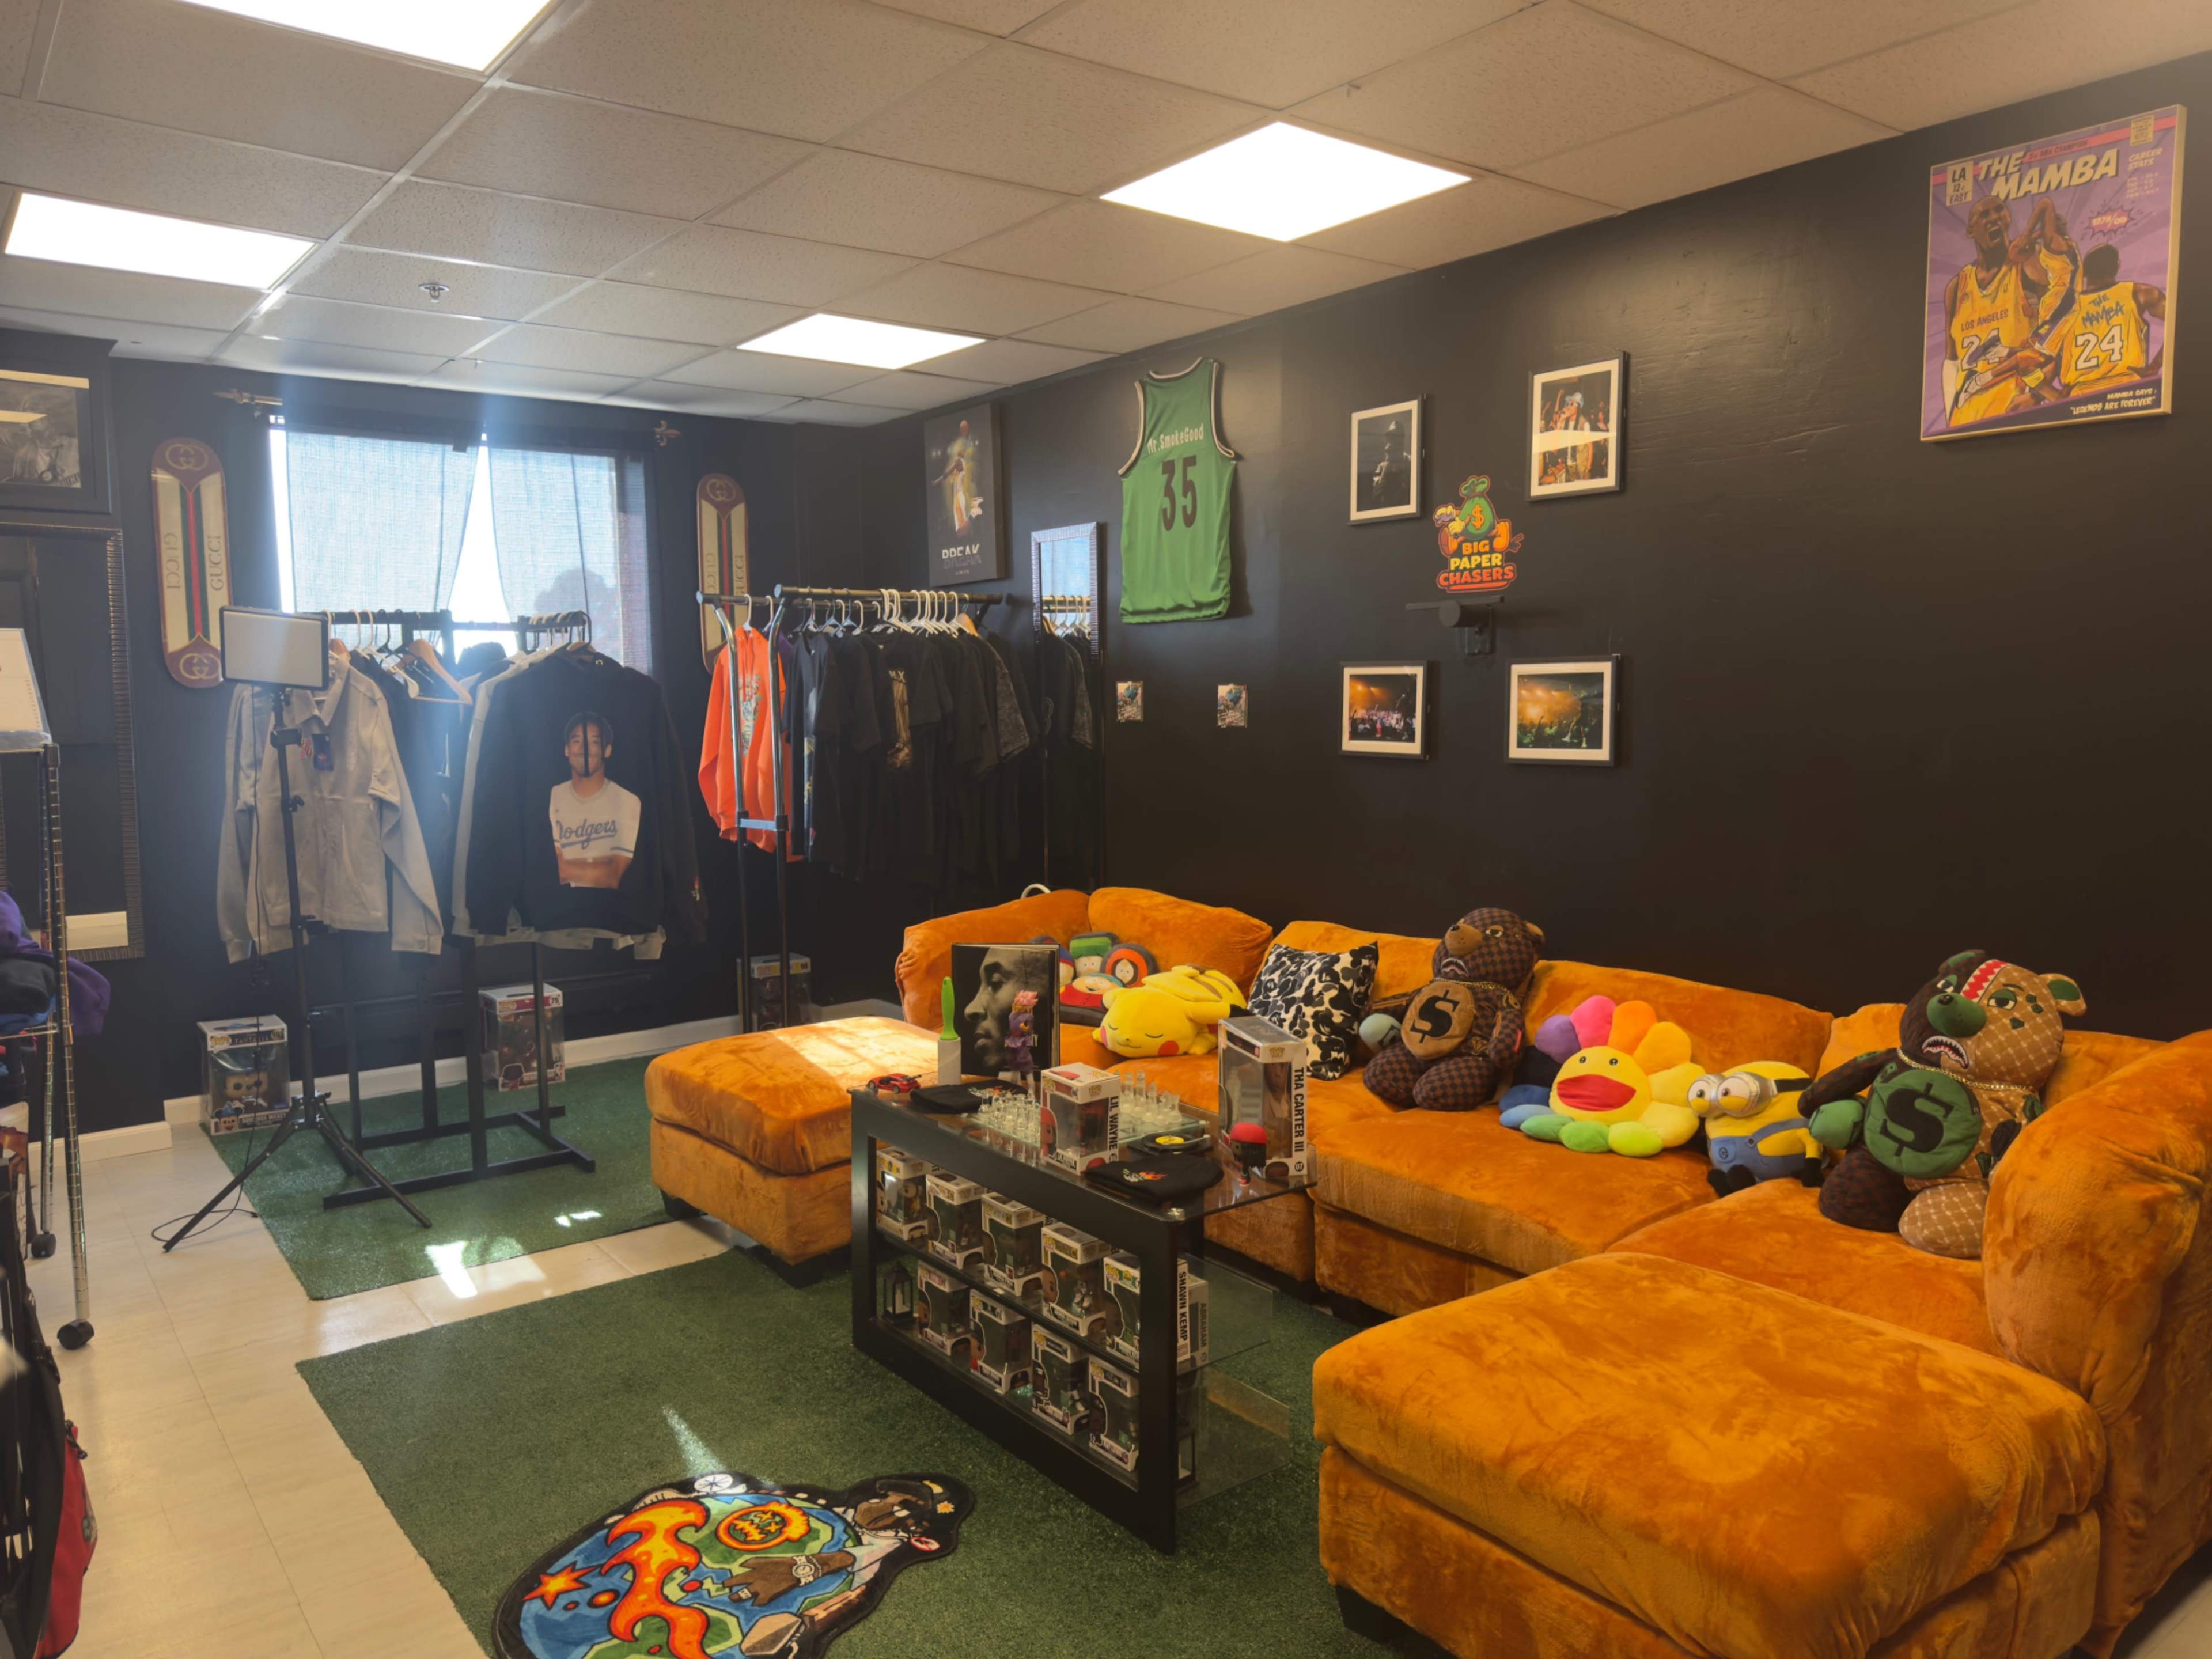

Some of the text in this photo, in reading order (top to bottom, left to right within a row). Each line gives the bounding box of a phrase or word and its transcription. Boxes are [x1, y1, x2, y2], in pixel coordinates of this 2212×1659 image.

[1952, 167, 1966, 183] LA
[1979, 151, 2027, 181] THE
[1990, 147, 2119, 201] MAMBA
[2090, 294, 2110, 306] THE
[1961, 308, 2009, 332] LOS ANGELES
[2081, 301, 2124, 329] MAMBA
[2075, 324, 2124, 371] 24
[2104, 400, 2119, 410] ARE
[2107, 391, 2133, 399] MAMBA
[1161, 454, 1197, 531] 35
[164, 532, 180, 589] GUCCI
[1450, 553, 1502, 570] PAPER
[1462, 540, 1490, 555] BIG
[207, 535, 224, 591] GUCCI
[1439, 566, 1514, 586] CHASERS
[1110, 1096, 1119, 1112] LIL
[1294, 1067, 1304, 1152] THA CARTER III
[1109, 1113, 1119, 1150] WAYNE
[1179, 1271, 1188, 1341] SHAWN KEMP
